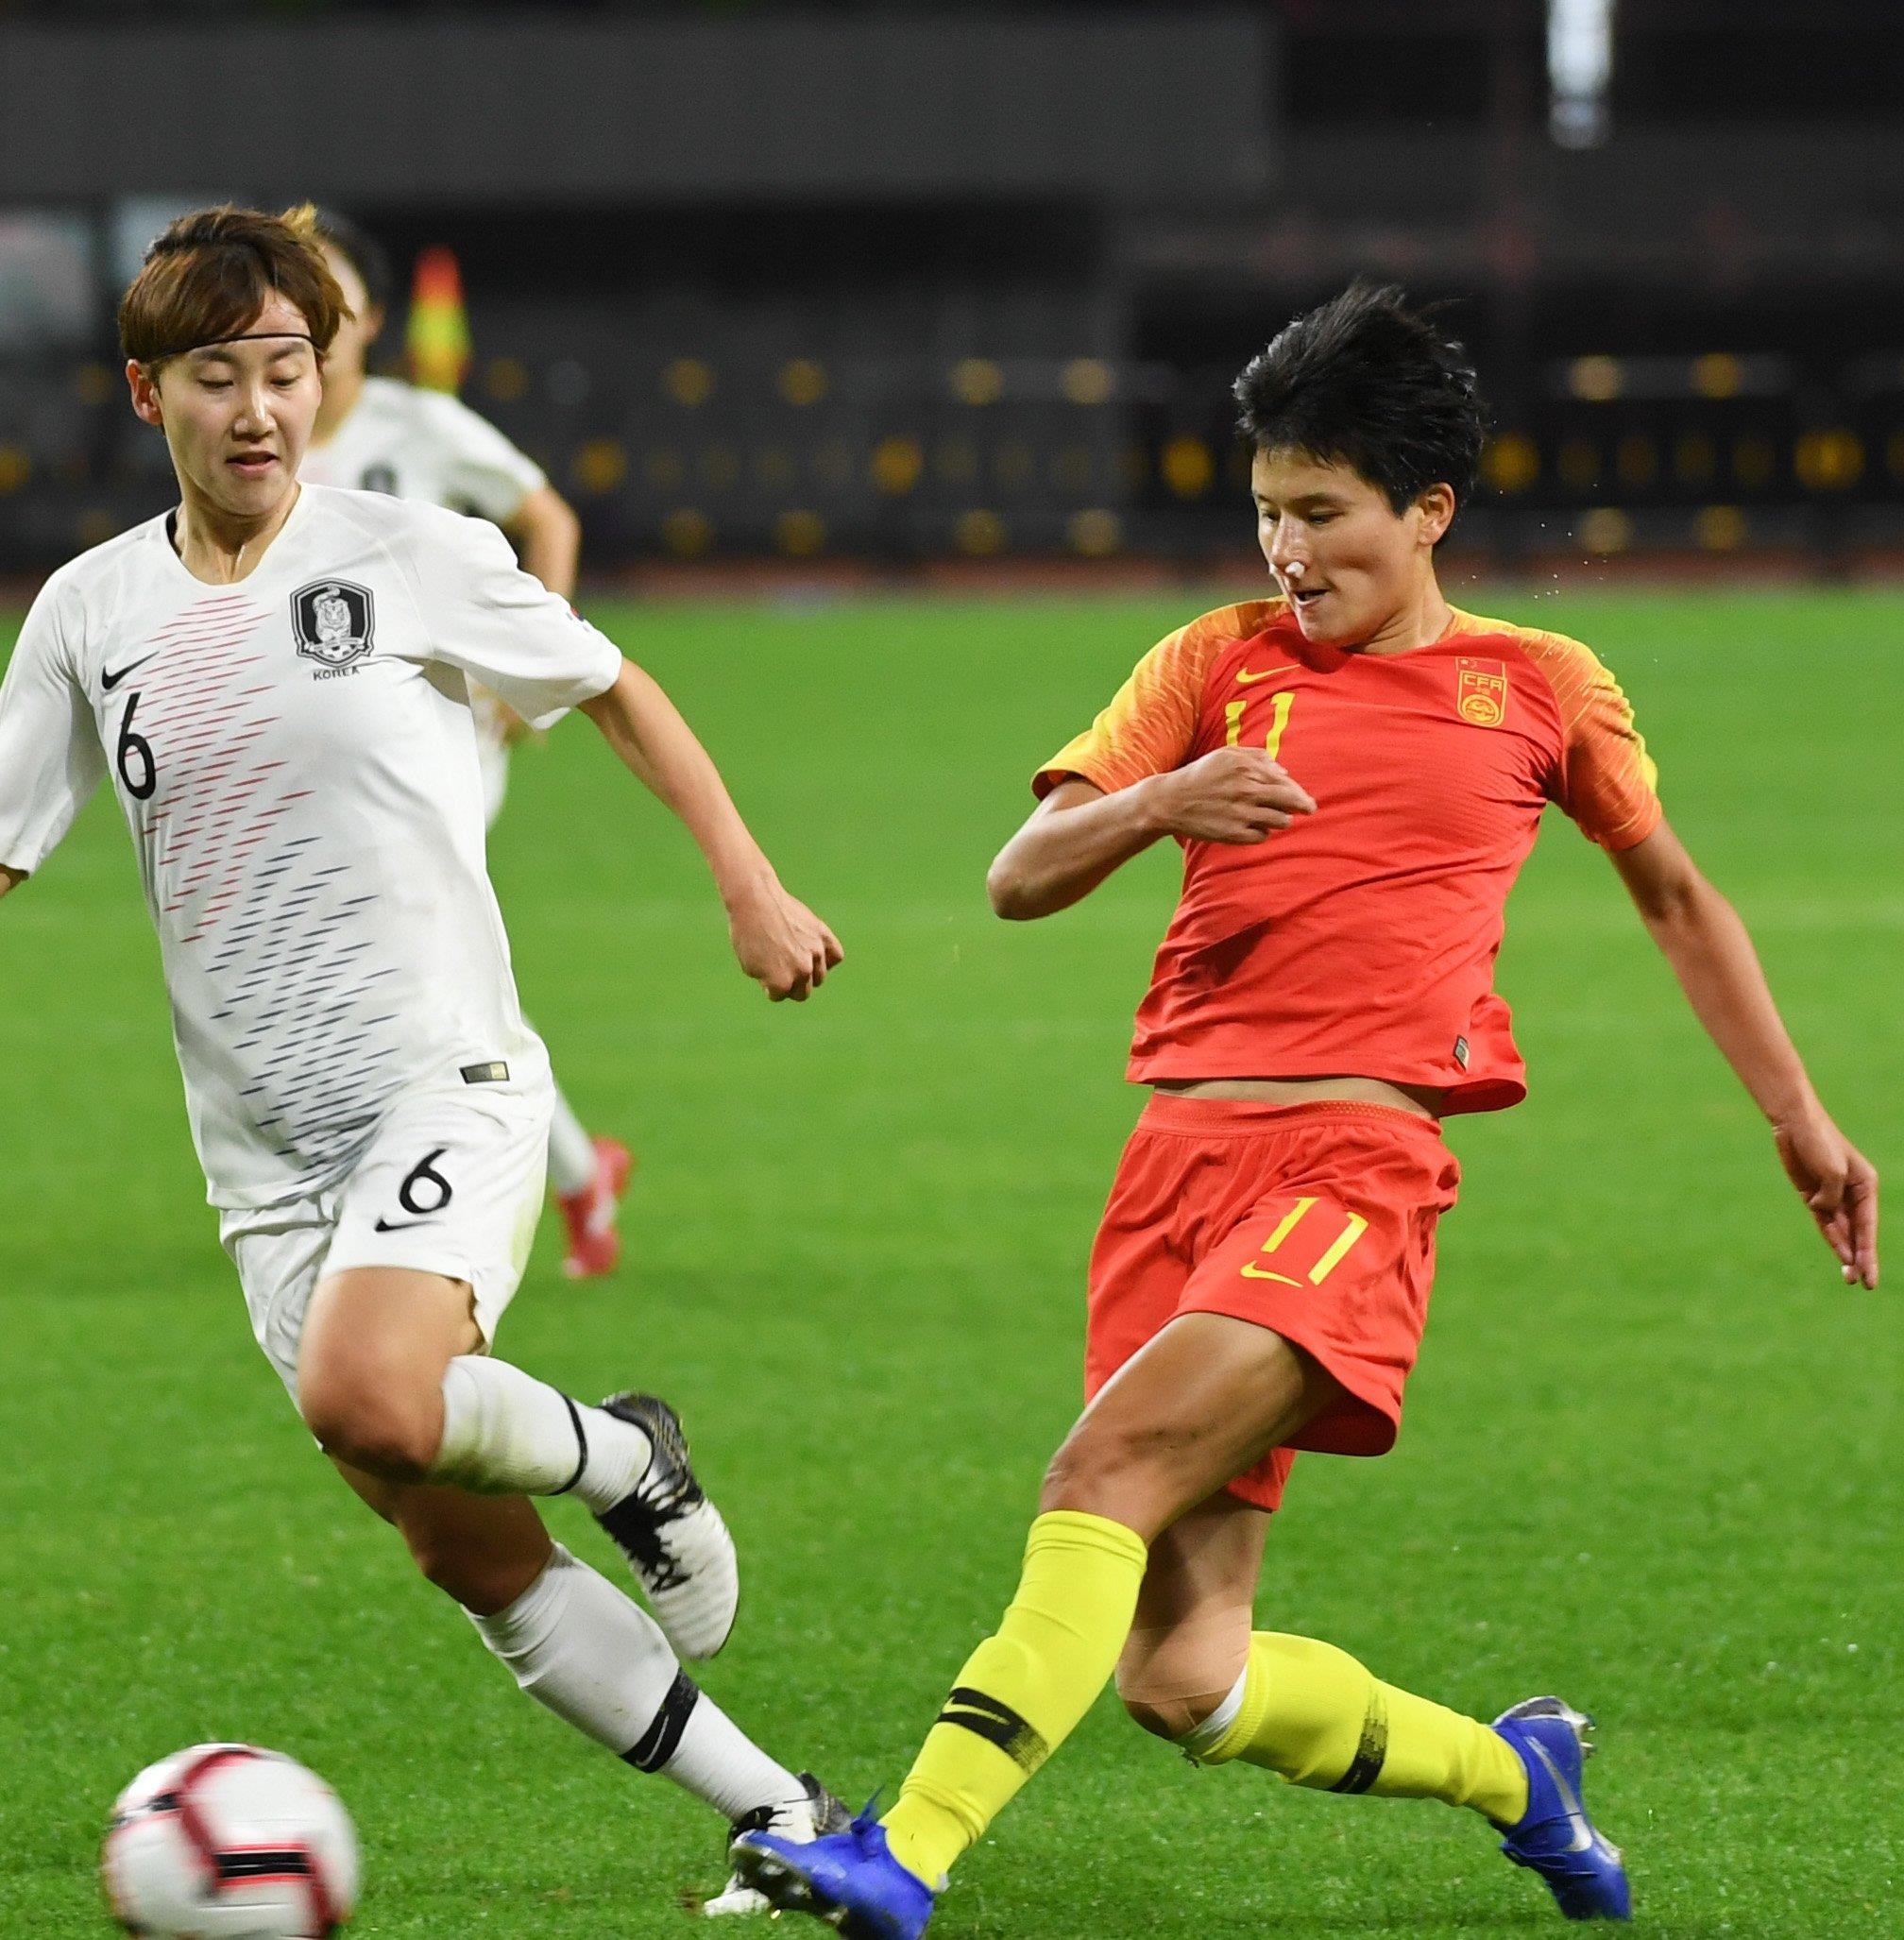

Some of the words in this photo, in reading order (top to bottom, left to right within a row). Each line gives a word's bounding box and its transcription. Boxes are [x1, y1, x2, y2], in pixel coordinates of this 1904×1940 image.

[1463, 672, 1504, 692] CFA
[116, 691, 157, 801] 6
[399, 1149, 453, 1215] 6
[1260, 1197, 1369, 1286] 11
